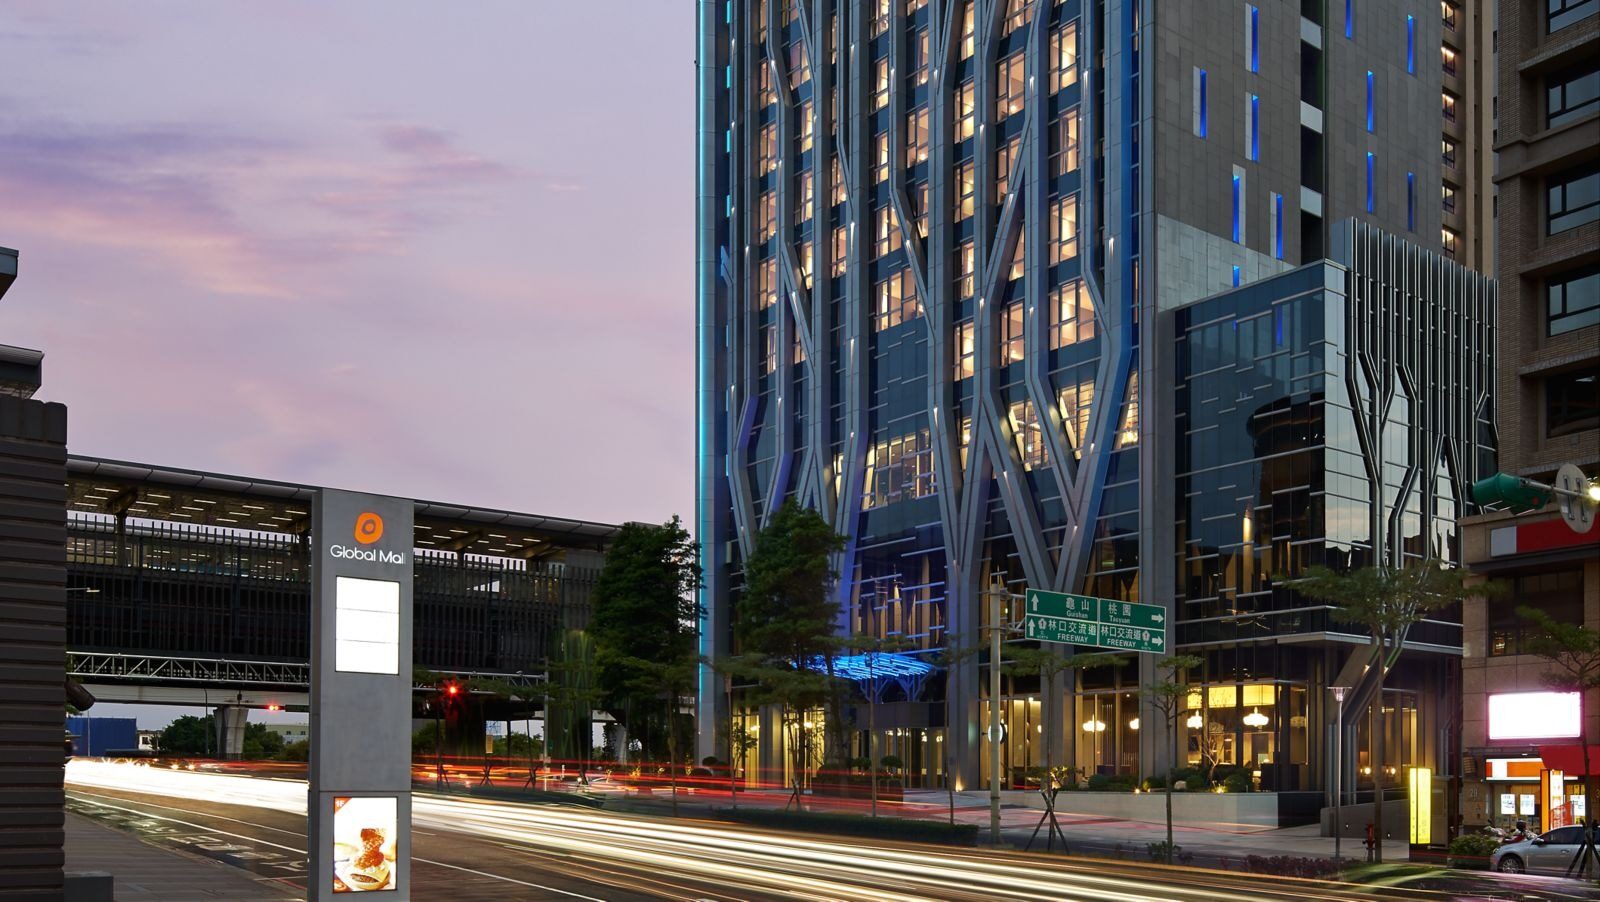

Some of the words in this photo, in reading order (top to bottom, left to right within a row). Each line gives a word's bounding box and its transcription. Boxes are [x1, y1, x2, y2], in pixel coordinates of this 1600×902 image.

[330, 545, 376, 561] Global
[1066, 610, 1089, 619] Guishan
[1108, 602, 1132, 616] 桃園
[1109, 615, 1131, 624] Taoyuan
[1048, 619, 1096, 636] 林口交流道
[1101, 625, 1141, 641] 林口交流道
[1057, 633, 1089, 643] FREEWAY
[1107, 638, 1137, 648] FREEWAY
